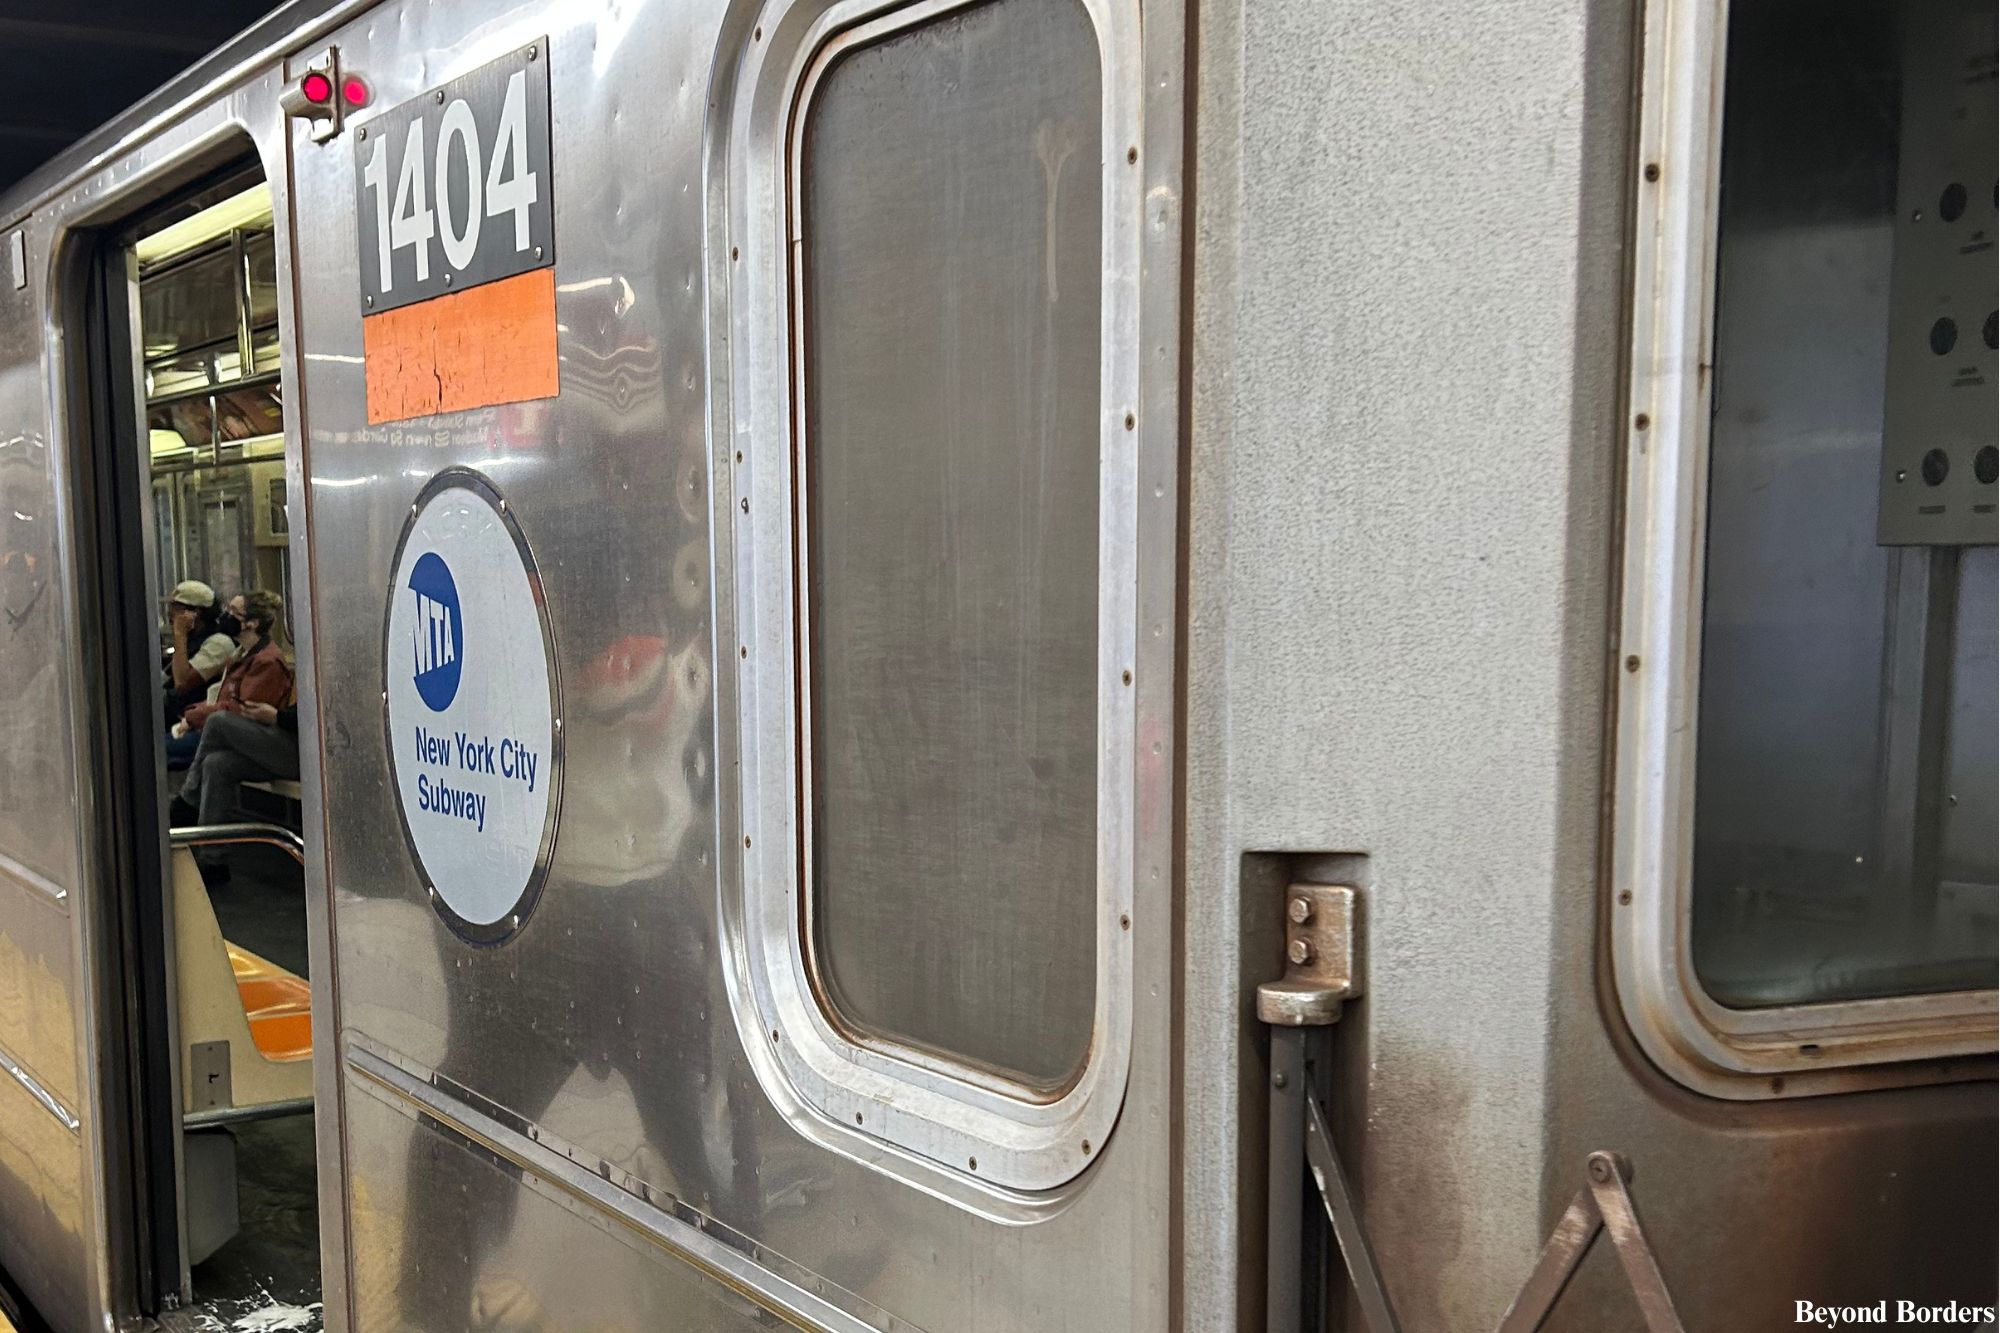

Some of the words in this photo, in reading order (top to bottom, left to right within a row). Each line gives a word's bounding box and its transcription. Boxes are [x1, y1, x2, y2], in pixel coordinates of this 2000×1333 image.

[364, 69, 538, 294] 1404
[412, 589, 455, 676] MTA
[415, 726, 450, 767] New
[455, 731, 495, 775] York
[500, 738, 538, 792] City
[418, 773, 486, 832] Subway
